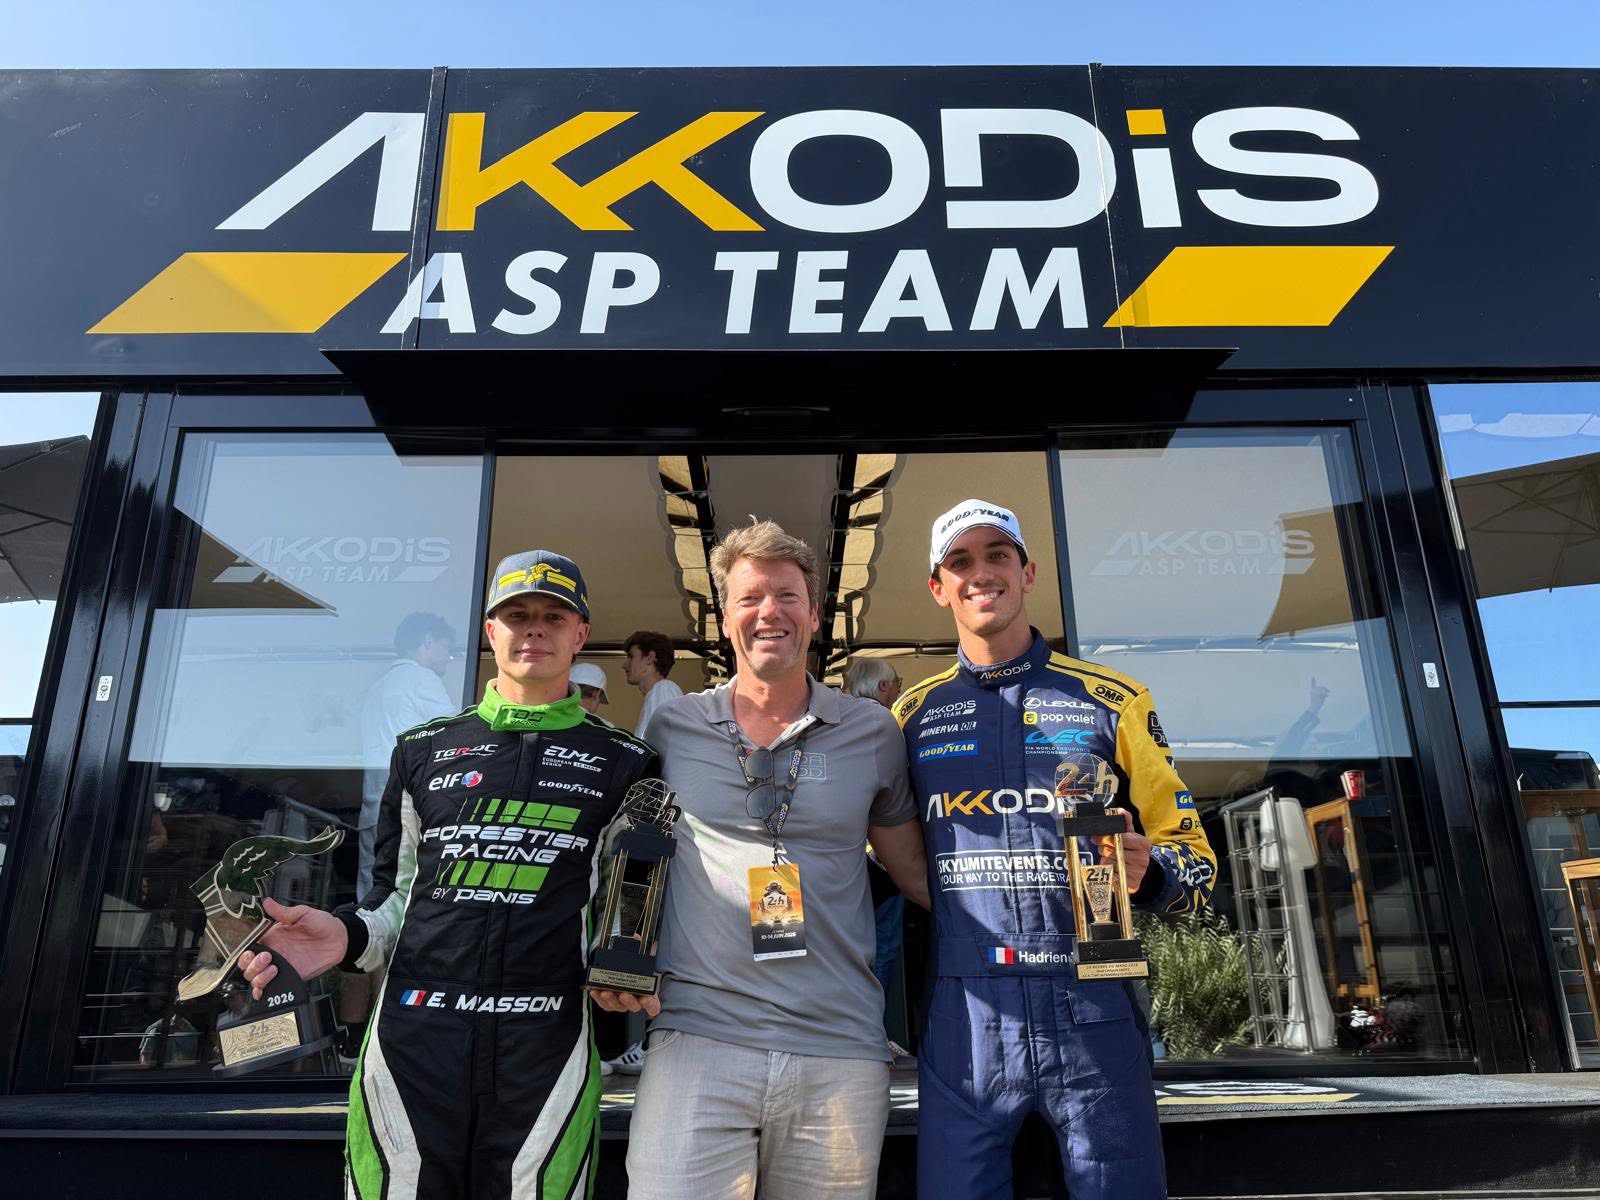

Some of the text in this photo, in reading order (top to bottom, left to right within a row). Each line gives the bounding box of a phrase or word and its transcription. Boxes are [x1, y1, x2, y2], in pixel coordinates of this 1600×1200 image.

[214, 106, 1379, 233] AKKODiS
[379, 247, 1088, 334] ASP TEAM
[941, 509, 1010, 533] GOODYEAR
[262, 566, 388, 583] ASP TEAM
[1138, 558, 1261, 575] ASP TEAM
[1095, 686, 1125, 703] OMP
[900, 698, 919, 717] OMP
[1042, 700, 1096, 710] LEXUS
[943, 710, 961, 719] TEAM
[1041, 713, 1095, 725] pop valet
[918, 721, 977, 739] MINERVA OIL
[1025, 729, 1095, 745] WEC
[919, 743, 975, 758] GOODYEAR
[542, 756, 572, 766] EUROPEAN
[428, 772, 462, 791] elf
[538, 780, 604, 798] GOODYEAR
[423, 825, 589, 852] FORESTIER
[440, 843, 561, 864] RACING
[938, 855, 1087, 874] SKYLIMITEVENTS.C
[963, 872, 982, 883] WAY
[985, 872, 1000, 882] TO
[1001, 872, 1023, 882] THE
[1026, 872, 1071, 883] RACETRA
[431, 887, 452, 899] BY
[1018, 950, 1067, 963] Hadrien
[267, 992, 294, 1007] 2026
[426, 991, 564, 1013] E. MASSON
